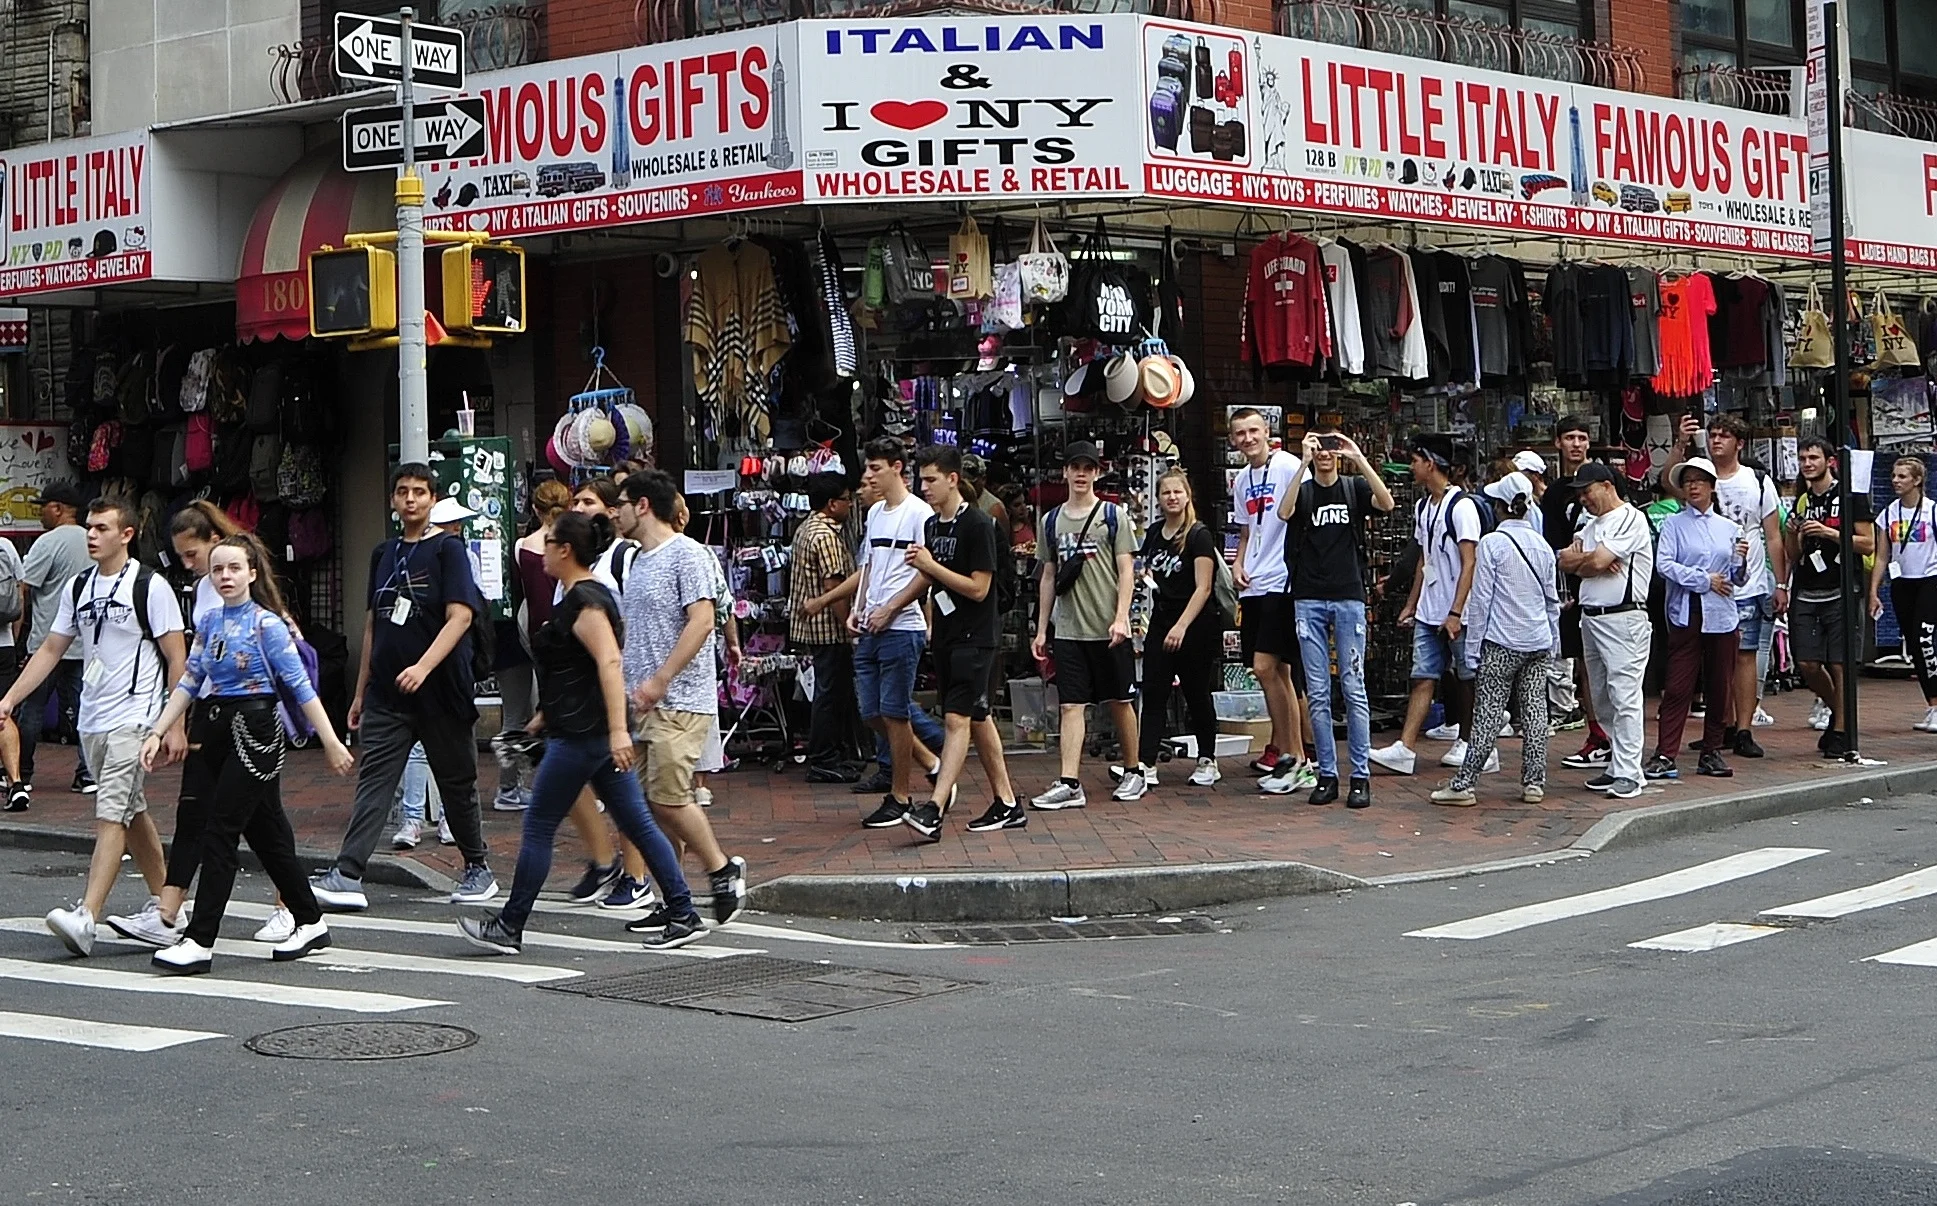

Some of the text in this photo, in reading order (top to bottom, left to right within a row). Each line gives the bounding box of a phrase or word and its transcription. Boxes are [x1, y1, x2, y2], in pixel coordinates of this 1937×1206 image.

[351, 36, 452, 69] ONE WAY
[826, 24, 1104, 55] ITALIAN
[940, 64, 993, 89] &
[1808, 61, 1815, 83] 3
[629, 46, 769, 146] GIFTS
[430, 73, 606, 172] MOUS
[821, 98, 1114, 131] I NY
[1301, 57, 1560, 171] LITTLE ITALY
[357, 118, 468, 149] ONE WAY
[632, 142, 767, 179] WHOLESALE & RETAIL
[861, 137, 1076, 167] GIFTS
[1305, 149, 1337, 168] 128 B
[1593, 103, 1808, 204] FAMOUS GIFT
[11, 145, 145, 232] LITTLE ITALY
[483, 173, 512, 198] TAXI
[816, 166, 1130, 197] WHOLESALE & RETAIL
[1480, 169, 1500, 192] TAXI
[1811, 172, 1818, 194] 2
[492, 209, 509, 231] NY
[511, 207, 520, 229] &
[522, 203, 568, 228] ITALIAN
[572, 197, 608, 222] GIFTS
[617, 187, 689, 218] SOUVENIRS
[728, 181, 797, 203] Yankees
[1151, 167, 1809, 254] LUGGAGE NYC TOYS PERFUMES WATCHES JEWELRY T-SHIRTS I NY & ITALIAN GIFTS SOUVENIRS SUN GLASSES
[1725, 200, 1786, 226] WHOLESALE
[1789, 208, 1796, 226] &
[953, 262, 969, 274] NY
[1859, 243, 1886, 262] LADIES
[1887, 245, 1908, 265] HAND
[0, 254, 145, 291] ERFUMES WATCHES JEWELRY
[263, 278, 305, 312] 180
[1099, 314, 1132, 333] CITY
[1881, 325, 1889, 337] I
[1881, 337, 1905, 351] NY
[1312, 503, 1350, 527] VANS
[1920, 622, 1937, 679] PYREX
